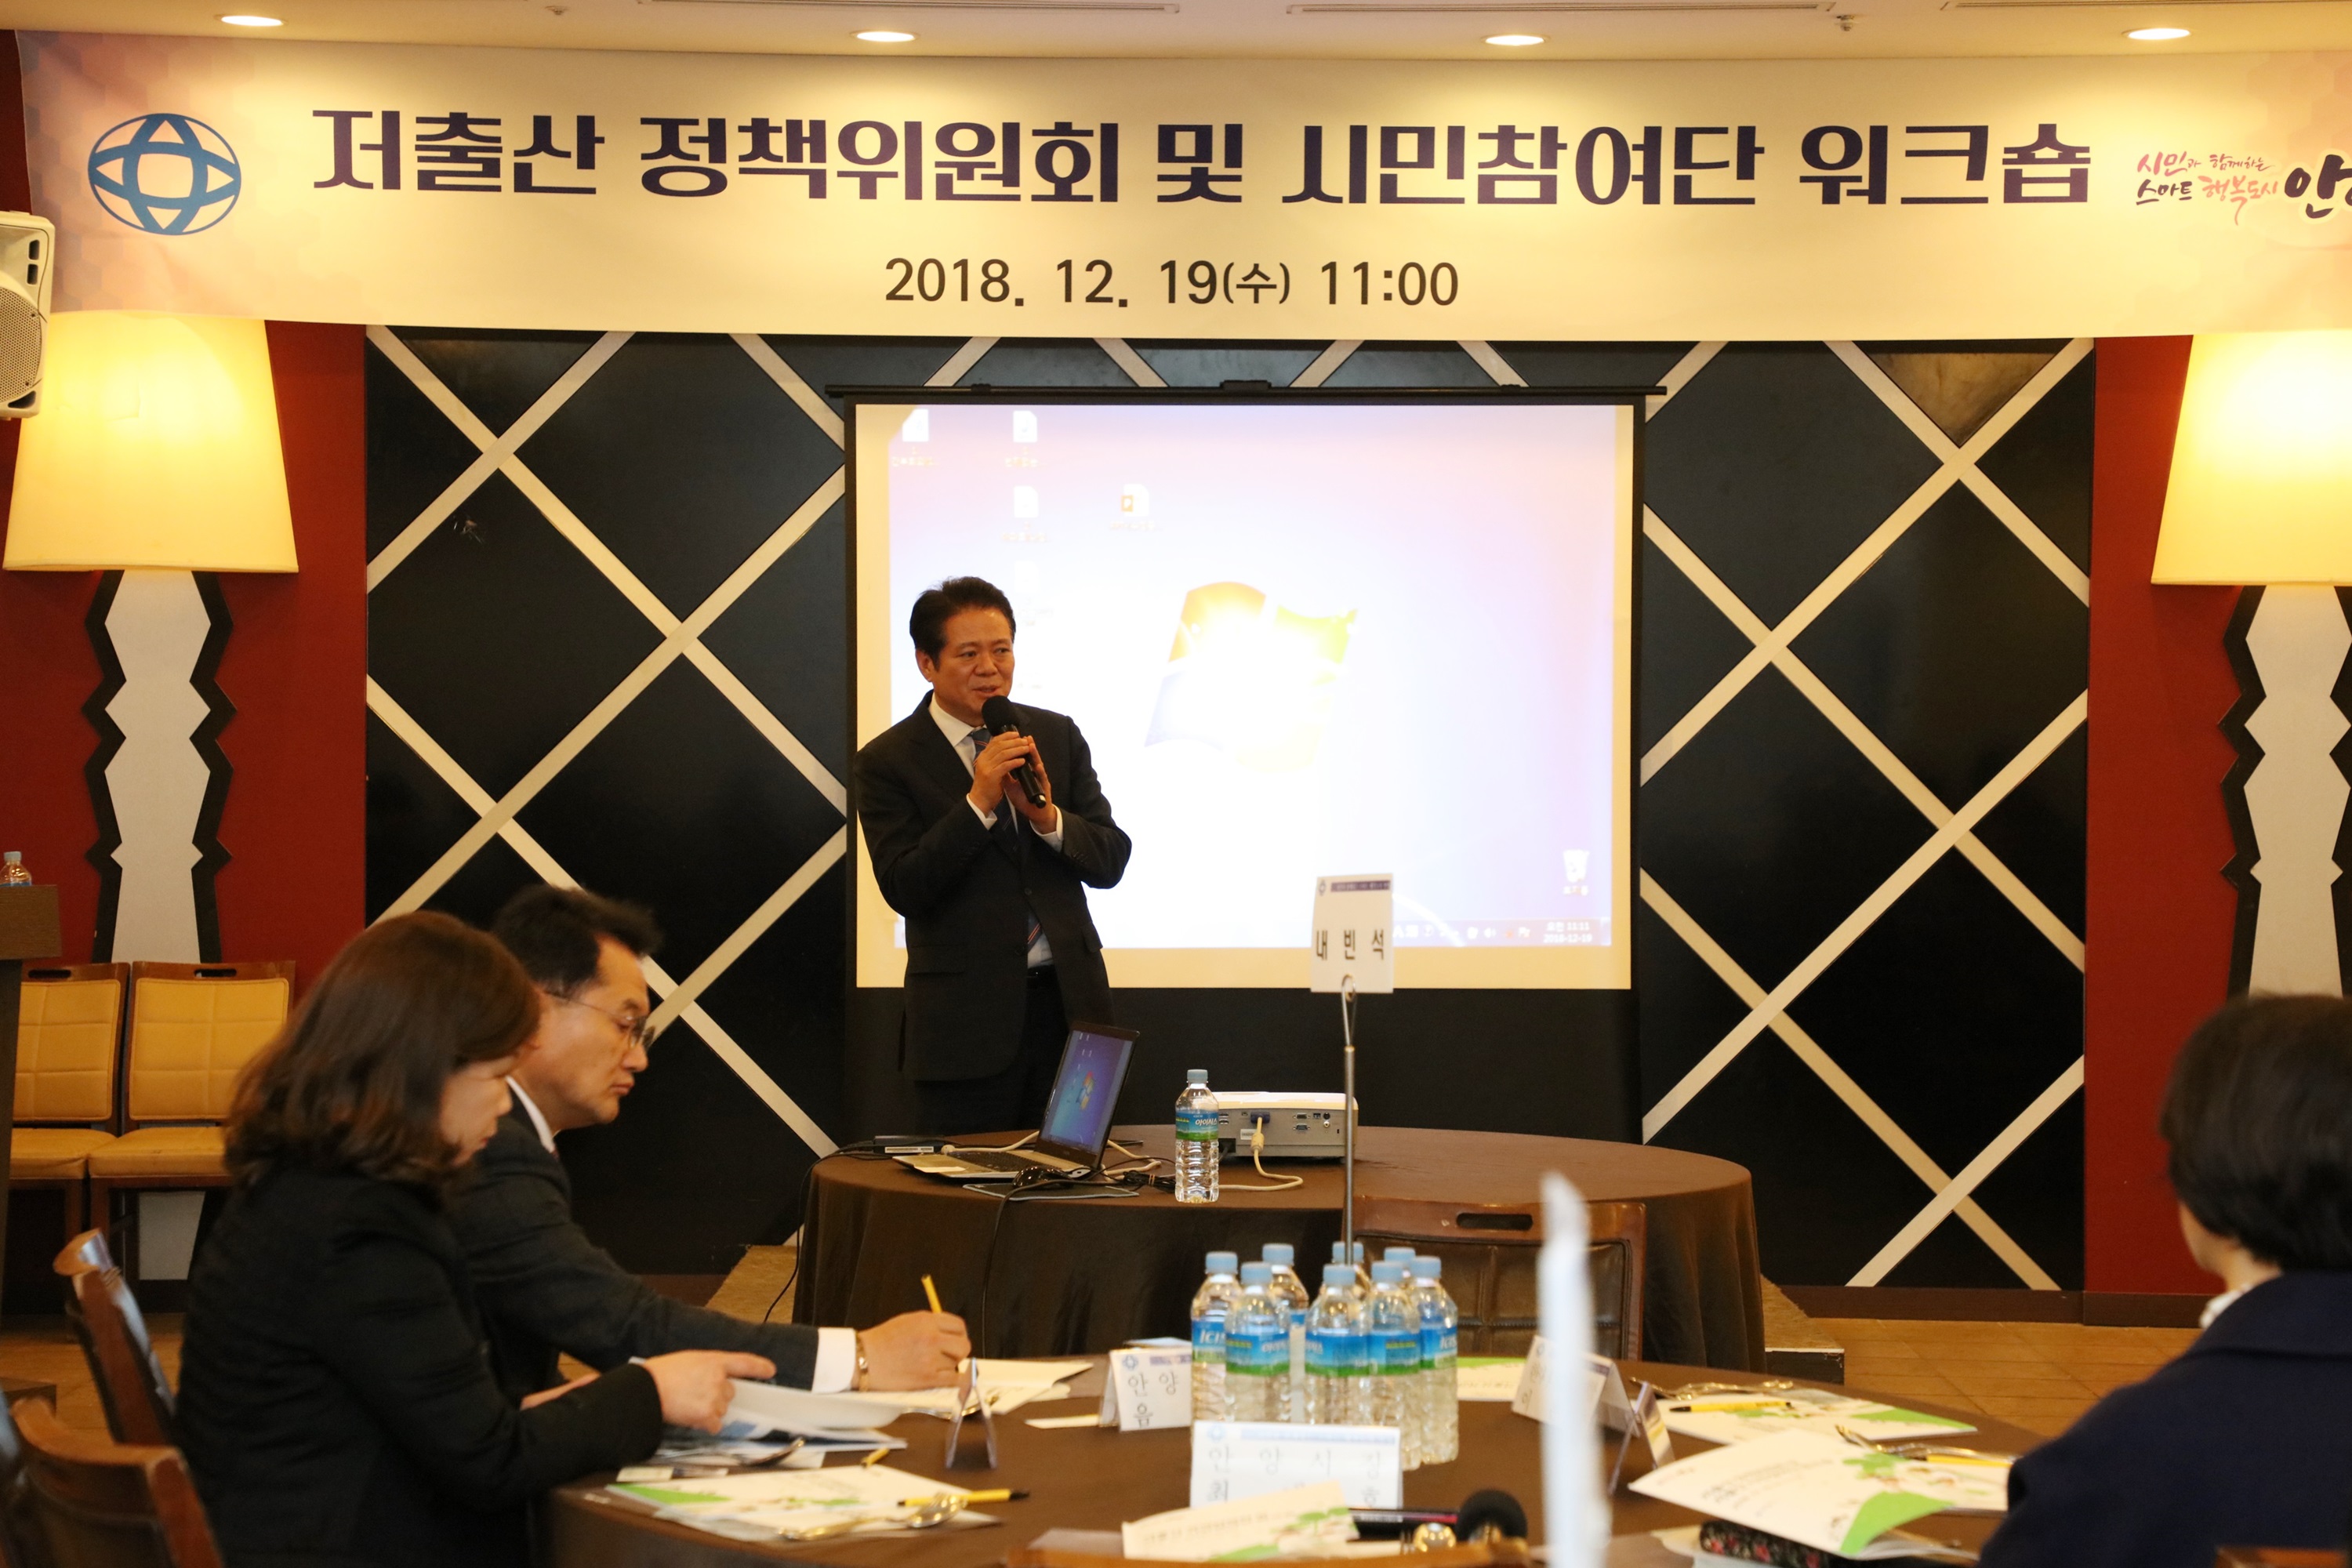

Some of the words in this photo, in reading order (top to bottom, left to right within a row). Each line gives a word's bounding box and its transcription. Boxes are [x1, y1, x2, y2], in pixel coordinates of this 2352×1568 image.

[313, 110, 605, 195] 저출산
[640, 117, 1120, 204] 정책위원회
[1156, 123, 1243, 204] 및
[1282, 125, 1766, 205] 시민참여단
[1798, 123, 2091, 205] 워크숍
[2136, 151, 2201, 177] 시민과
[2209, 154, 2276, 172] 함께하는
[2136, 179, 2194, 205] 스마트
[2197, 175, 2279, 226] 행복도시
[2284, 154, 2352, 220] 안
[885, 257, 1025, 307] 2018.
[1056, 259, 1129, 308] 12.
[1160, 260, 1291, 305] 19(수)
[1321, 261, 1459, 306] 11:00
